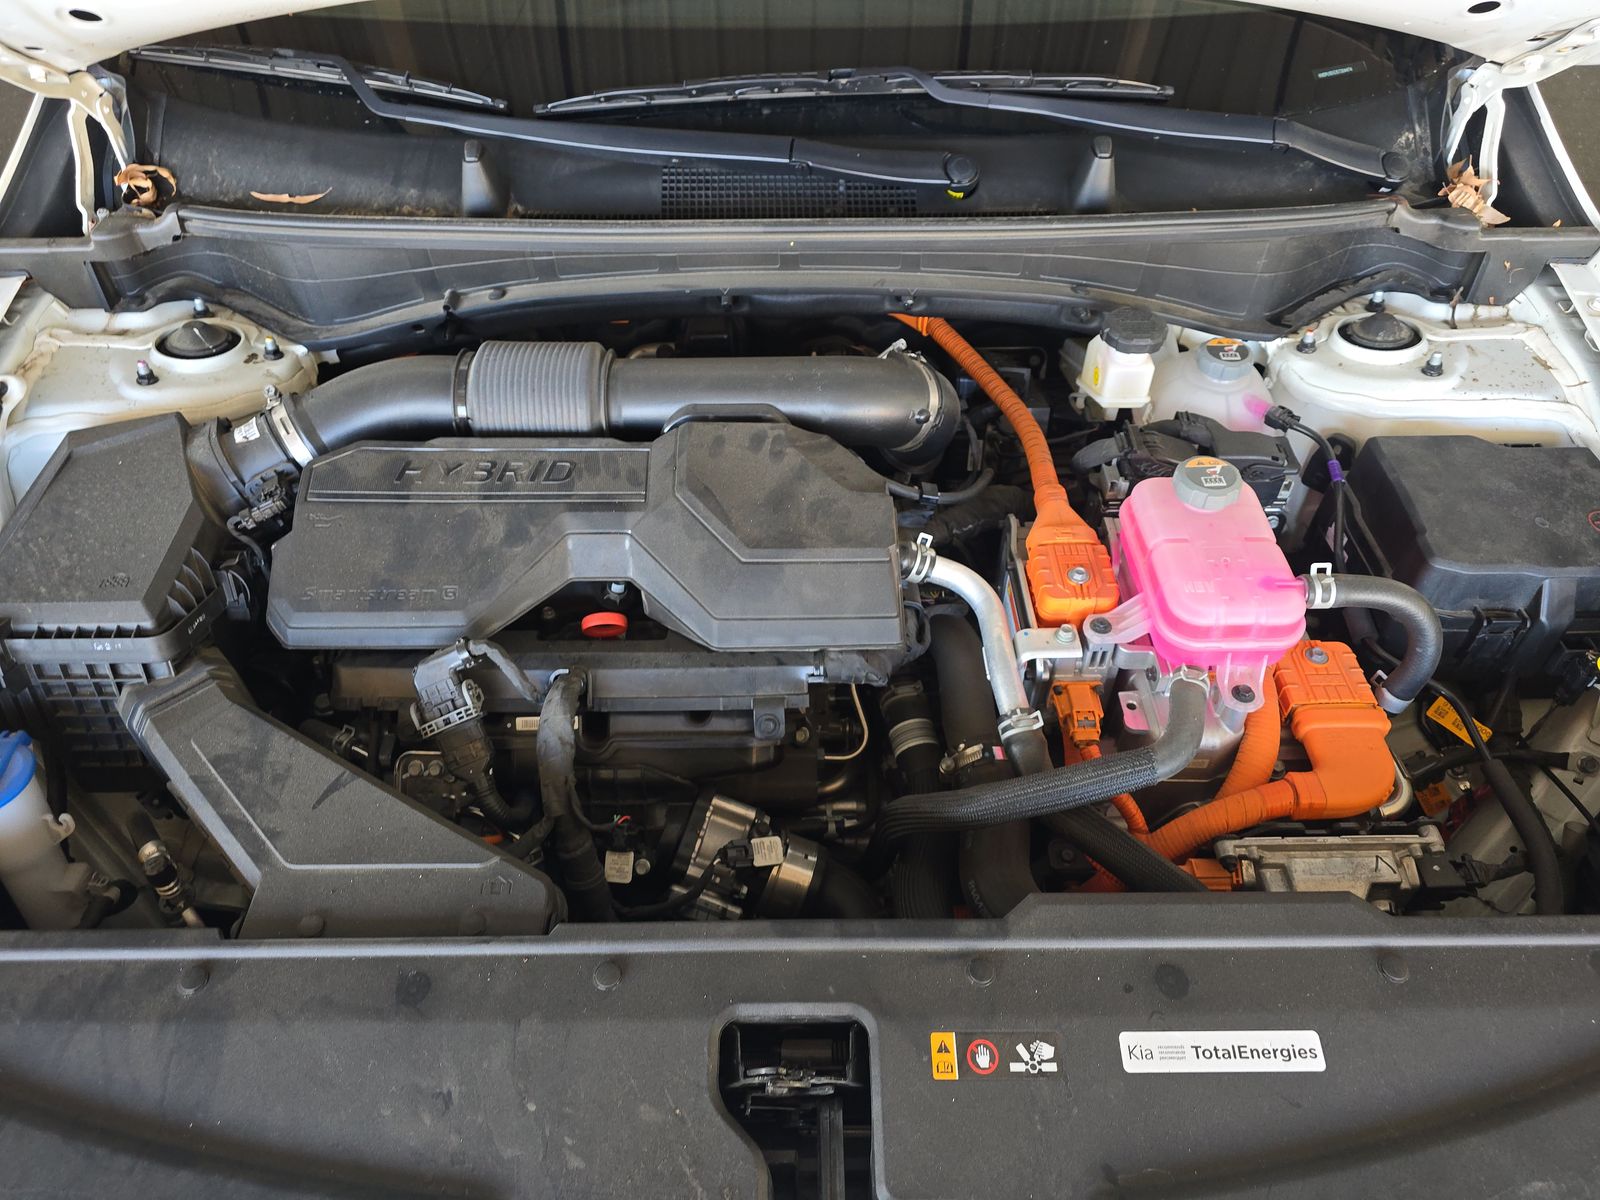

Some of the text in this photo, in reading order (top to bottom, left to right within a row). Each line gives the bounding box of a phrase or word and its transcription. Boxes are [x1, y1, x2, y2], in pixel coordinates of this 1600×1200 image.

[394, 459, 577, 485] HYBRID
[1127, 1044, 1318, 1063] Kia TotalEnergies
